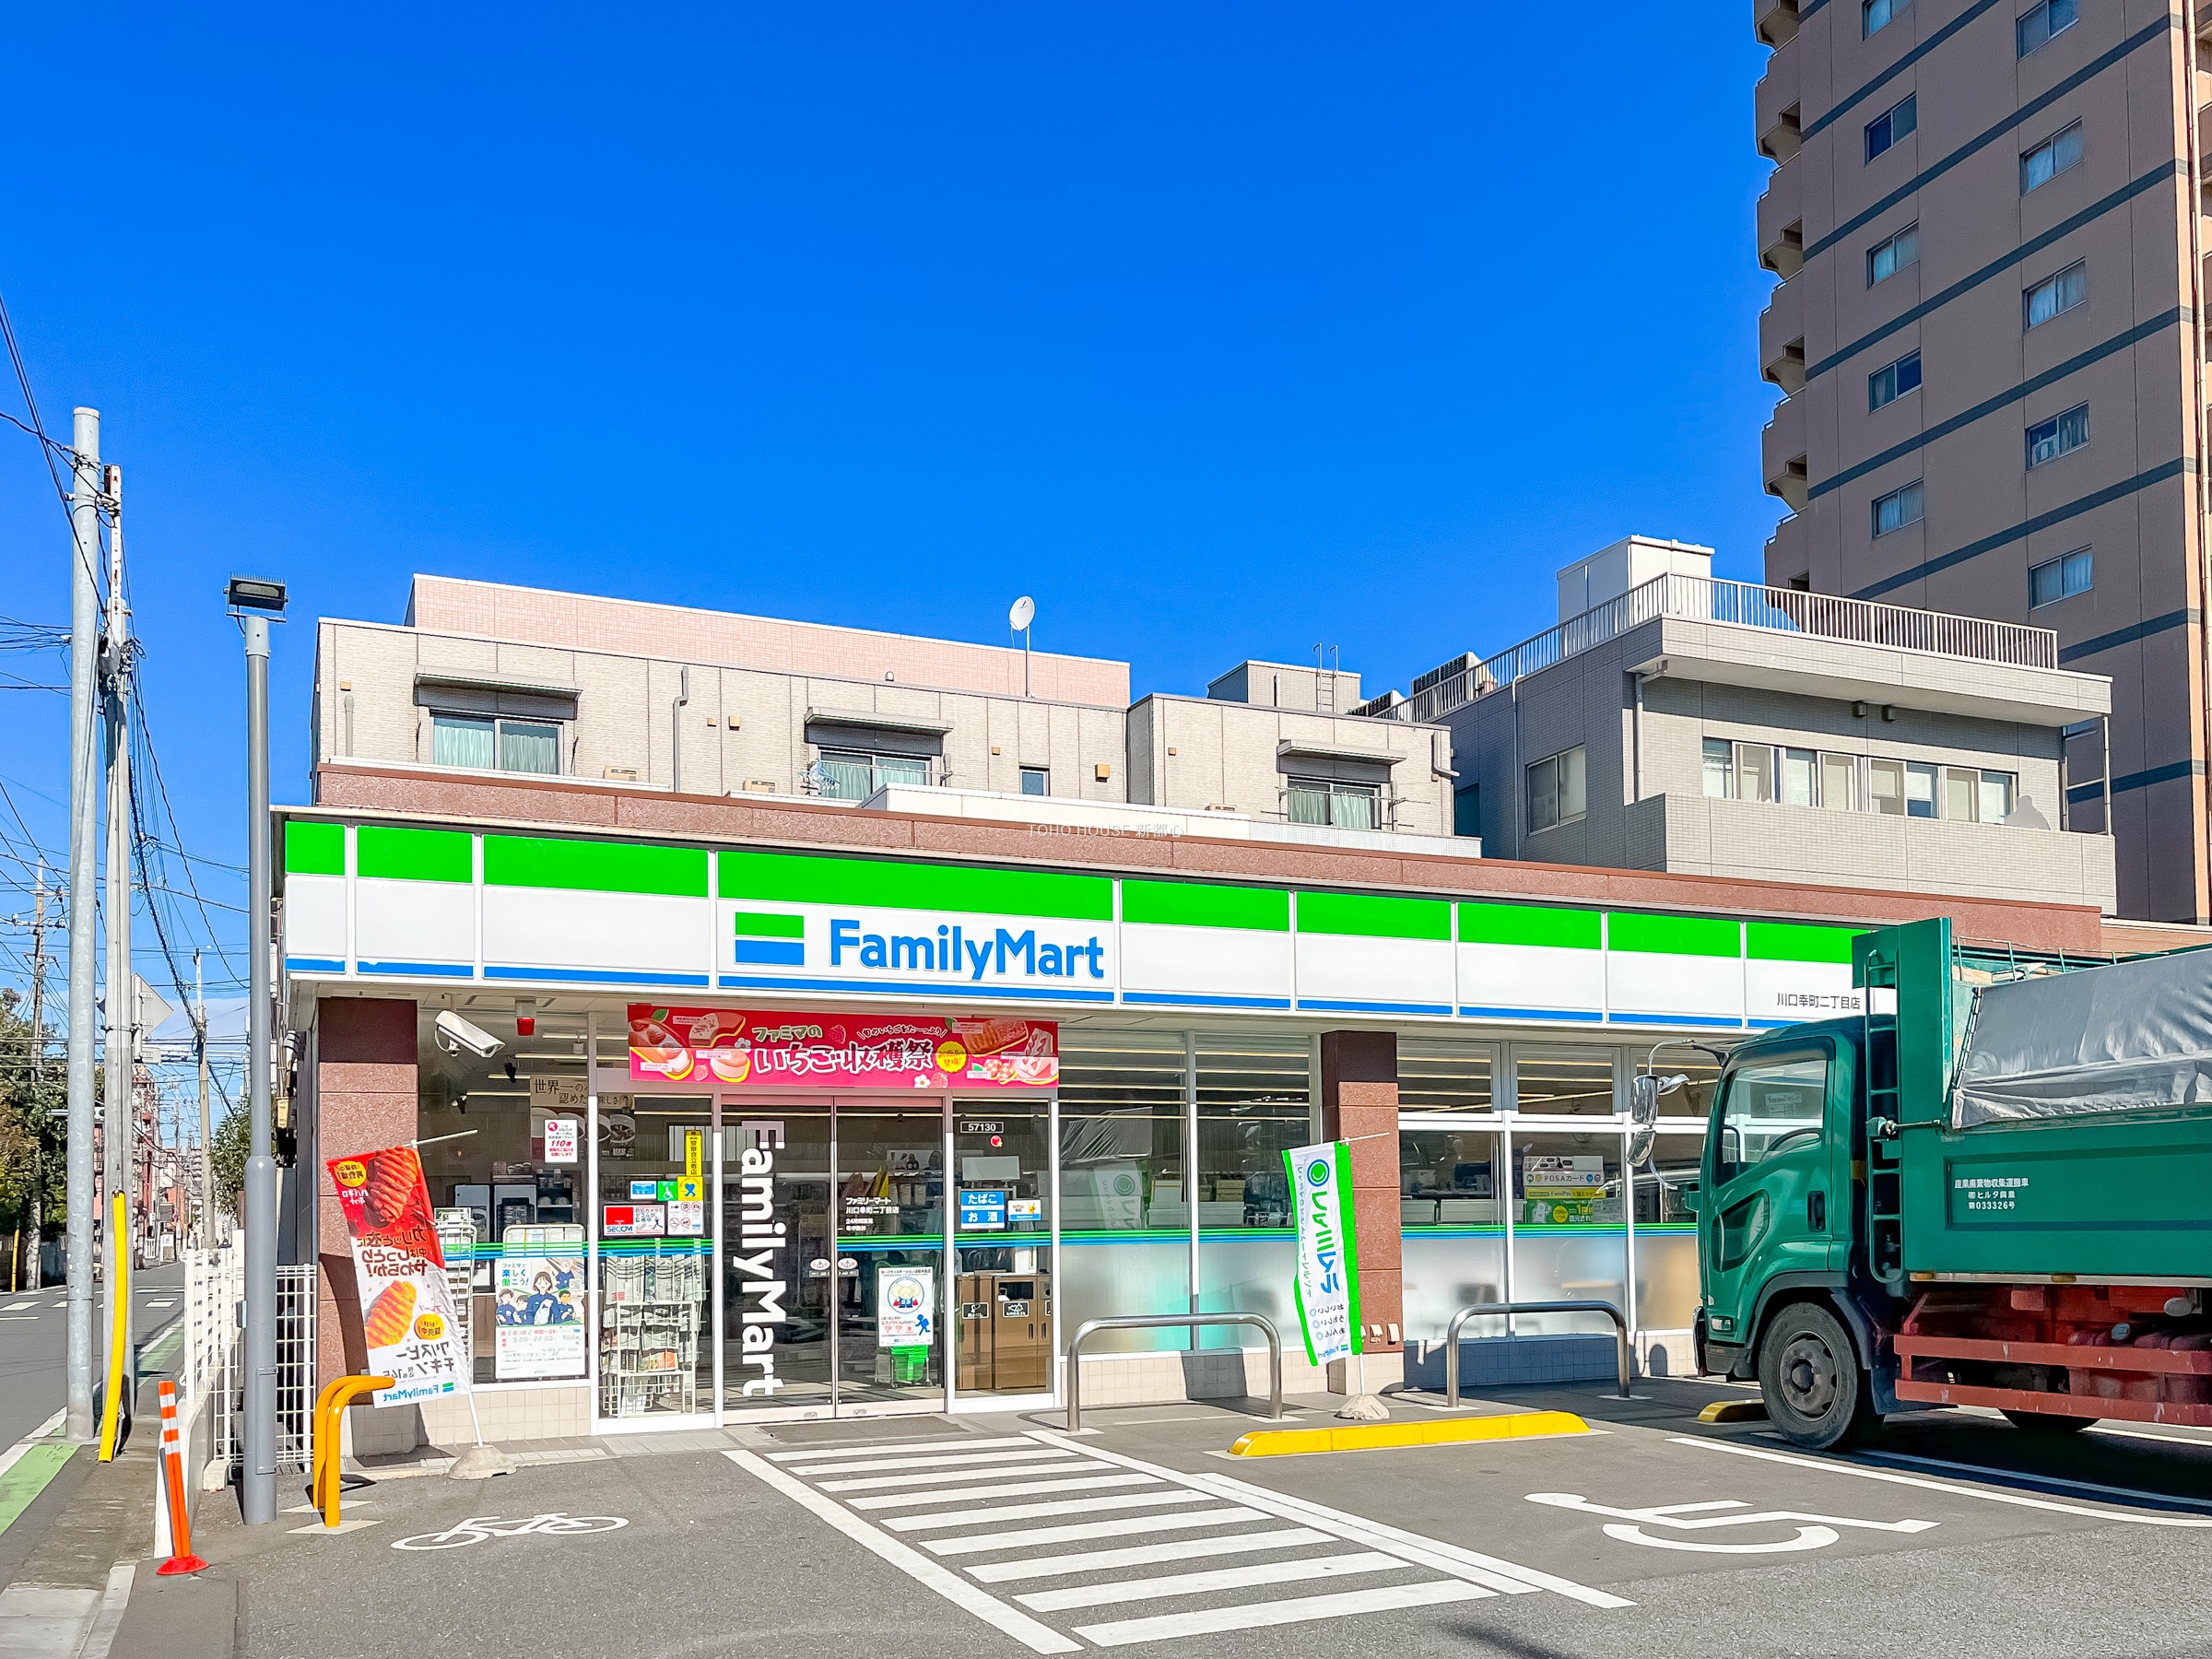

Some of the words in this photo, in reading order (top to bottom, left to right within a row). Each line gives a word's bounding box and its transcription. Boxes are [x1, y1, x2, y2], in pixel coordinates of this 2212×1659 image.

[830, 919, 1104, 981] FamilyMart
[1777, 993, 1861, 1009] 川口幸町二丁目店
[752, 1025, 823, 1042] ファミマの
[754, 1038, 934, 1076] いちご収穫祭
[533, 1078, 588, 1095] 世界一の
[968, 1124, 996, 1132] 57130
[1954, 1178, 2029, 1189] 産業廃棄物収集運搬車
[845, 1196, 892, 1206] ファミリーマート
[968, 1194, 997, 1205] たばこ
[1968, 1201, 2016, 1209] 第033326号
[845, 1206, 900, 1215] 川口幸町二丁目店
[733, 1121, 786, 1397] FamilyMart
[502, 1269, 526, 1277] 楽しく
[502, 1278, 529, 1287] 働こう!
